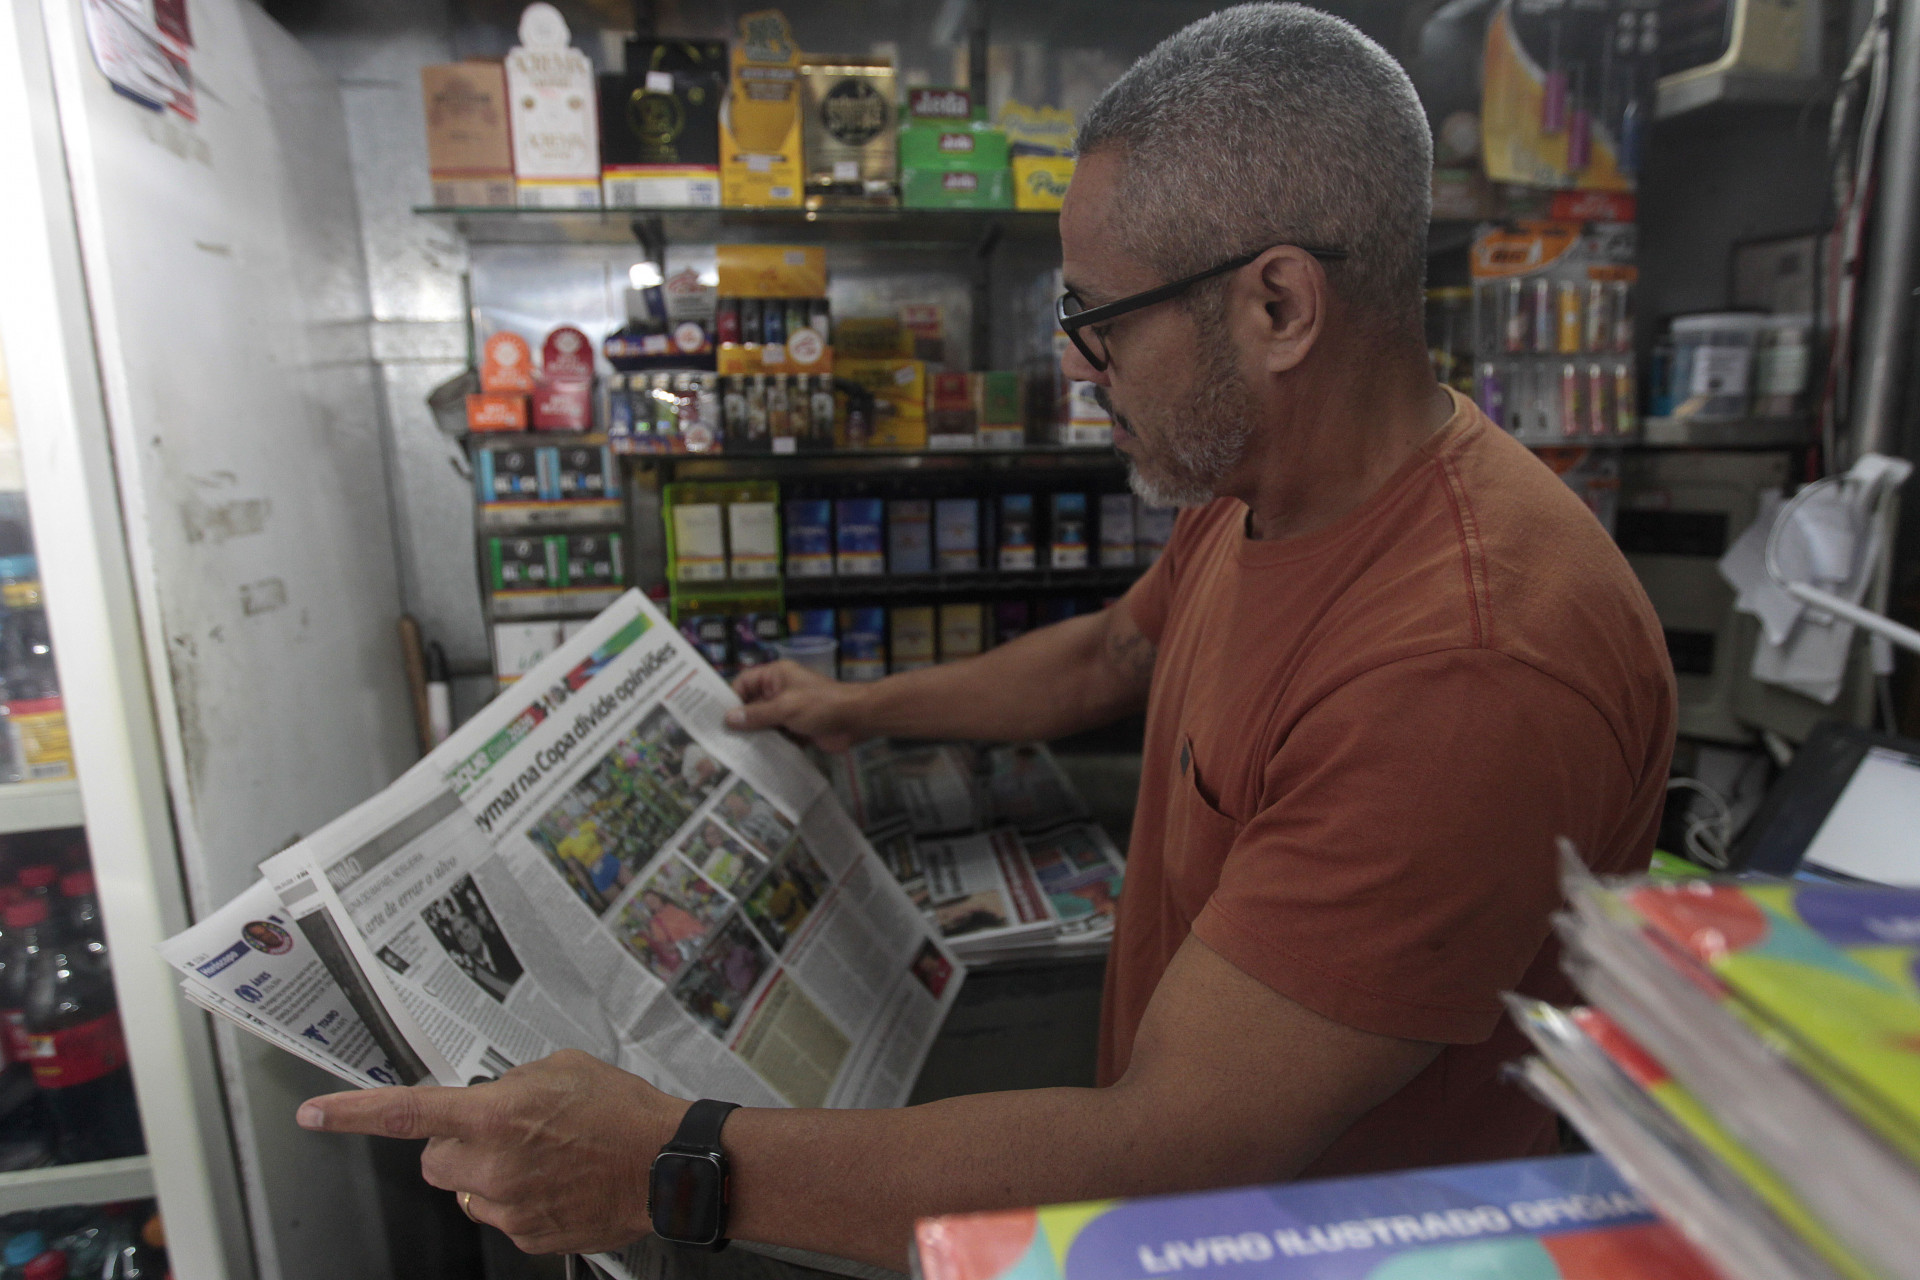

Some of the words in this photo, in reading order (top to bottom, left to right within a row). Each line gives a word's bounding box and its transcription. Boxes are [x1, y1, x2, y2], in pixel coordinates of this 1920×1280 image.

[518, 765, 542, 792] na
[535, 732, 577, 772] Copa
[573, 693, 617, 739] divide
[615, 642, 677, 700] opiniões
[384, 899, 399, 919] de
[398, 879, 425, 908] errar
[425, 872, 434, 887] o
[433, 855, 457, 880] alvo
[1138, 1231, 1275, 1273] LIVRO
[1273, 1203, 1512, 1257] ILUSTRADO
